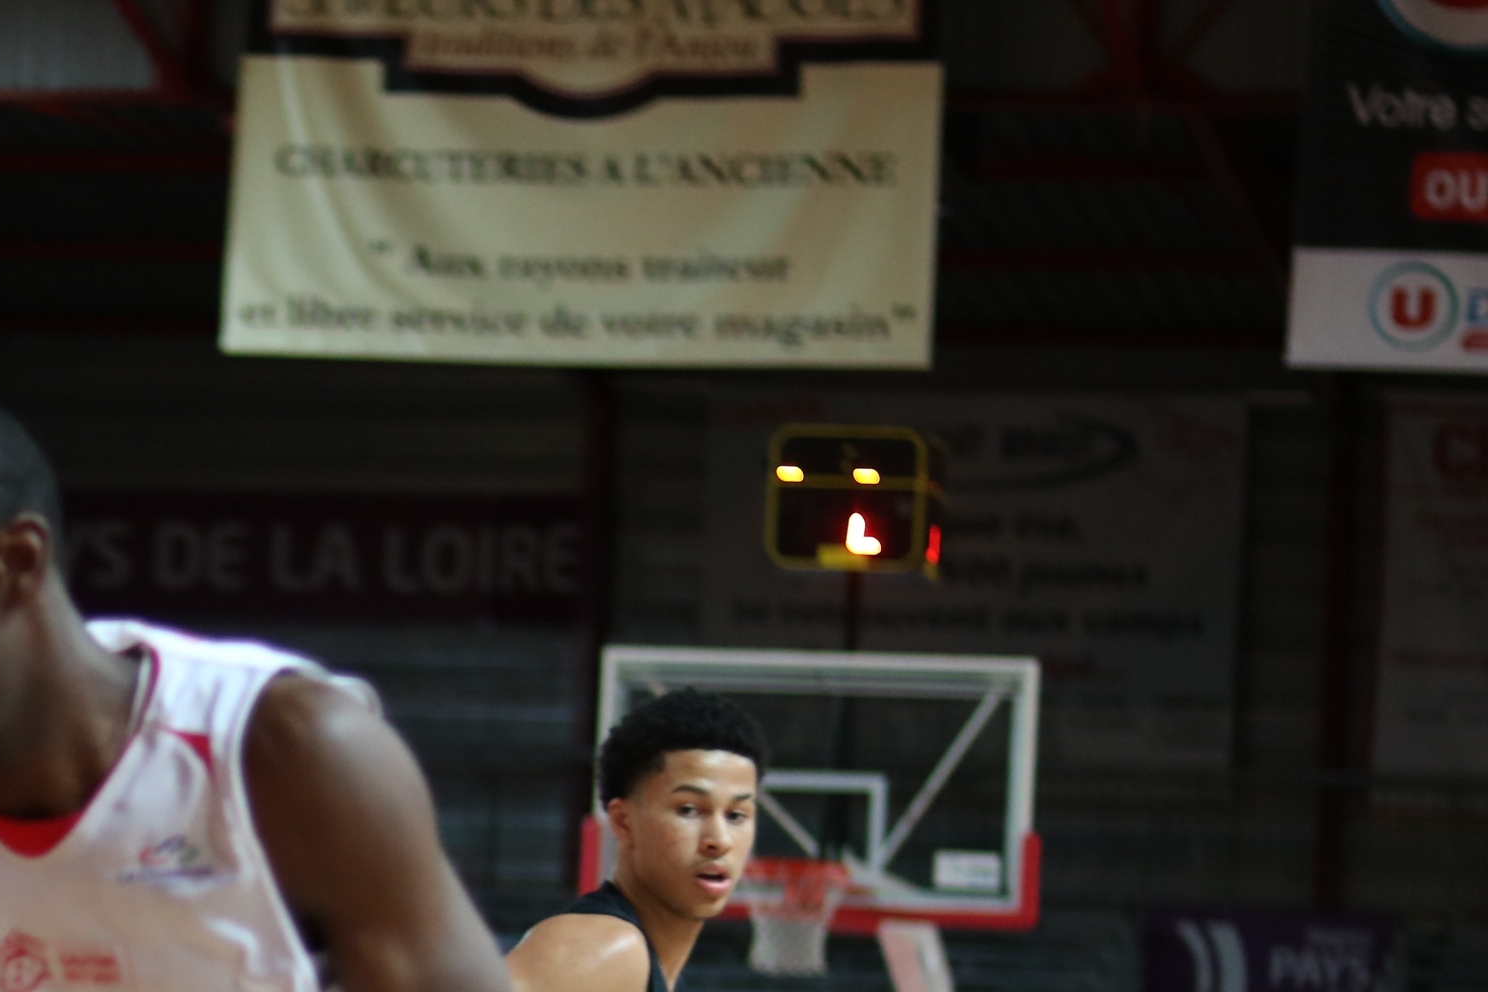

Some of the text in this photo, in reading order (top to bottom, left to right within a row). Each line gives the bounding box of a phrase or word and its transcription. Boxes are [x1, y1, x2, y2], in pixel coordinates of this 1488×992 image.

[1346, 82, 1457, 129] Votre
[147, 521, 250, 593] DE
[268, 522, 362, 594] LA
[378, 522, 580, 597] LOIRE
